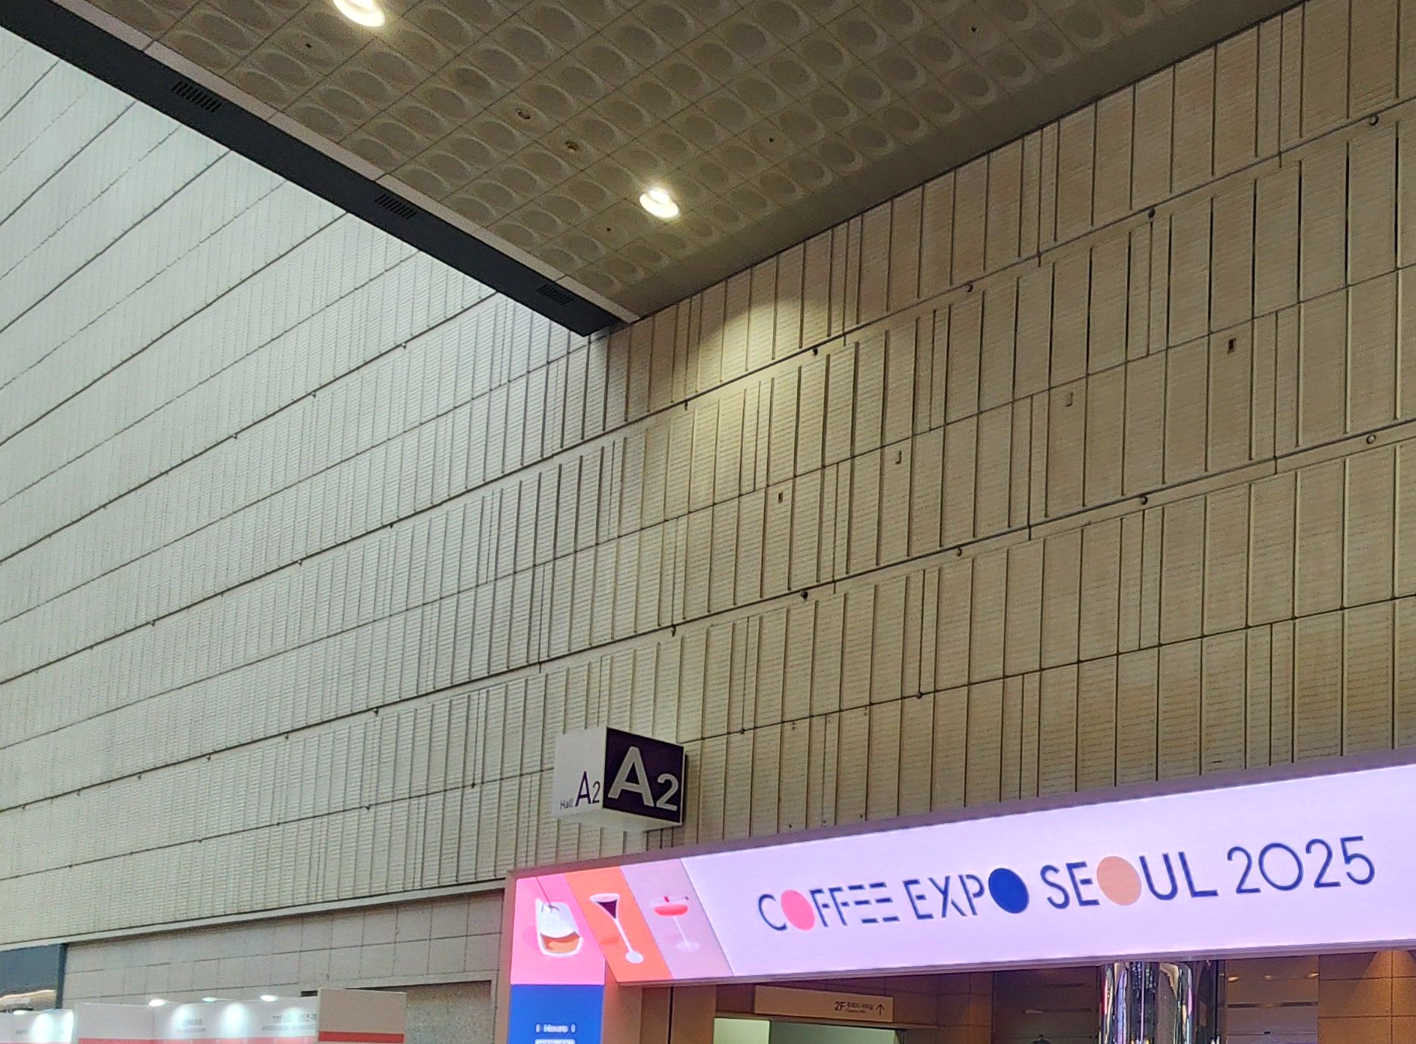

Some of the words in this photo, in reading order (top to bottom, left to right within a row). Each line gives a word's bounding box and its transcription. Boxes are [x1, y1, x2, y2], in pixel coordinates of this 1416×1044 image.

[560, 798, 573, 810] Hall
[575, 770, 600, 807] A2
[607, 746, 679, 812] A2
[757, 881, 899, 932] COFFEE
[910, 866, 1029, 920] EXPO
[1040, 851, 1219, 909] SEOUL
[1227, 835, 1375, 895] 2025
[835, 1001, 845, 1011] 2F
